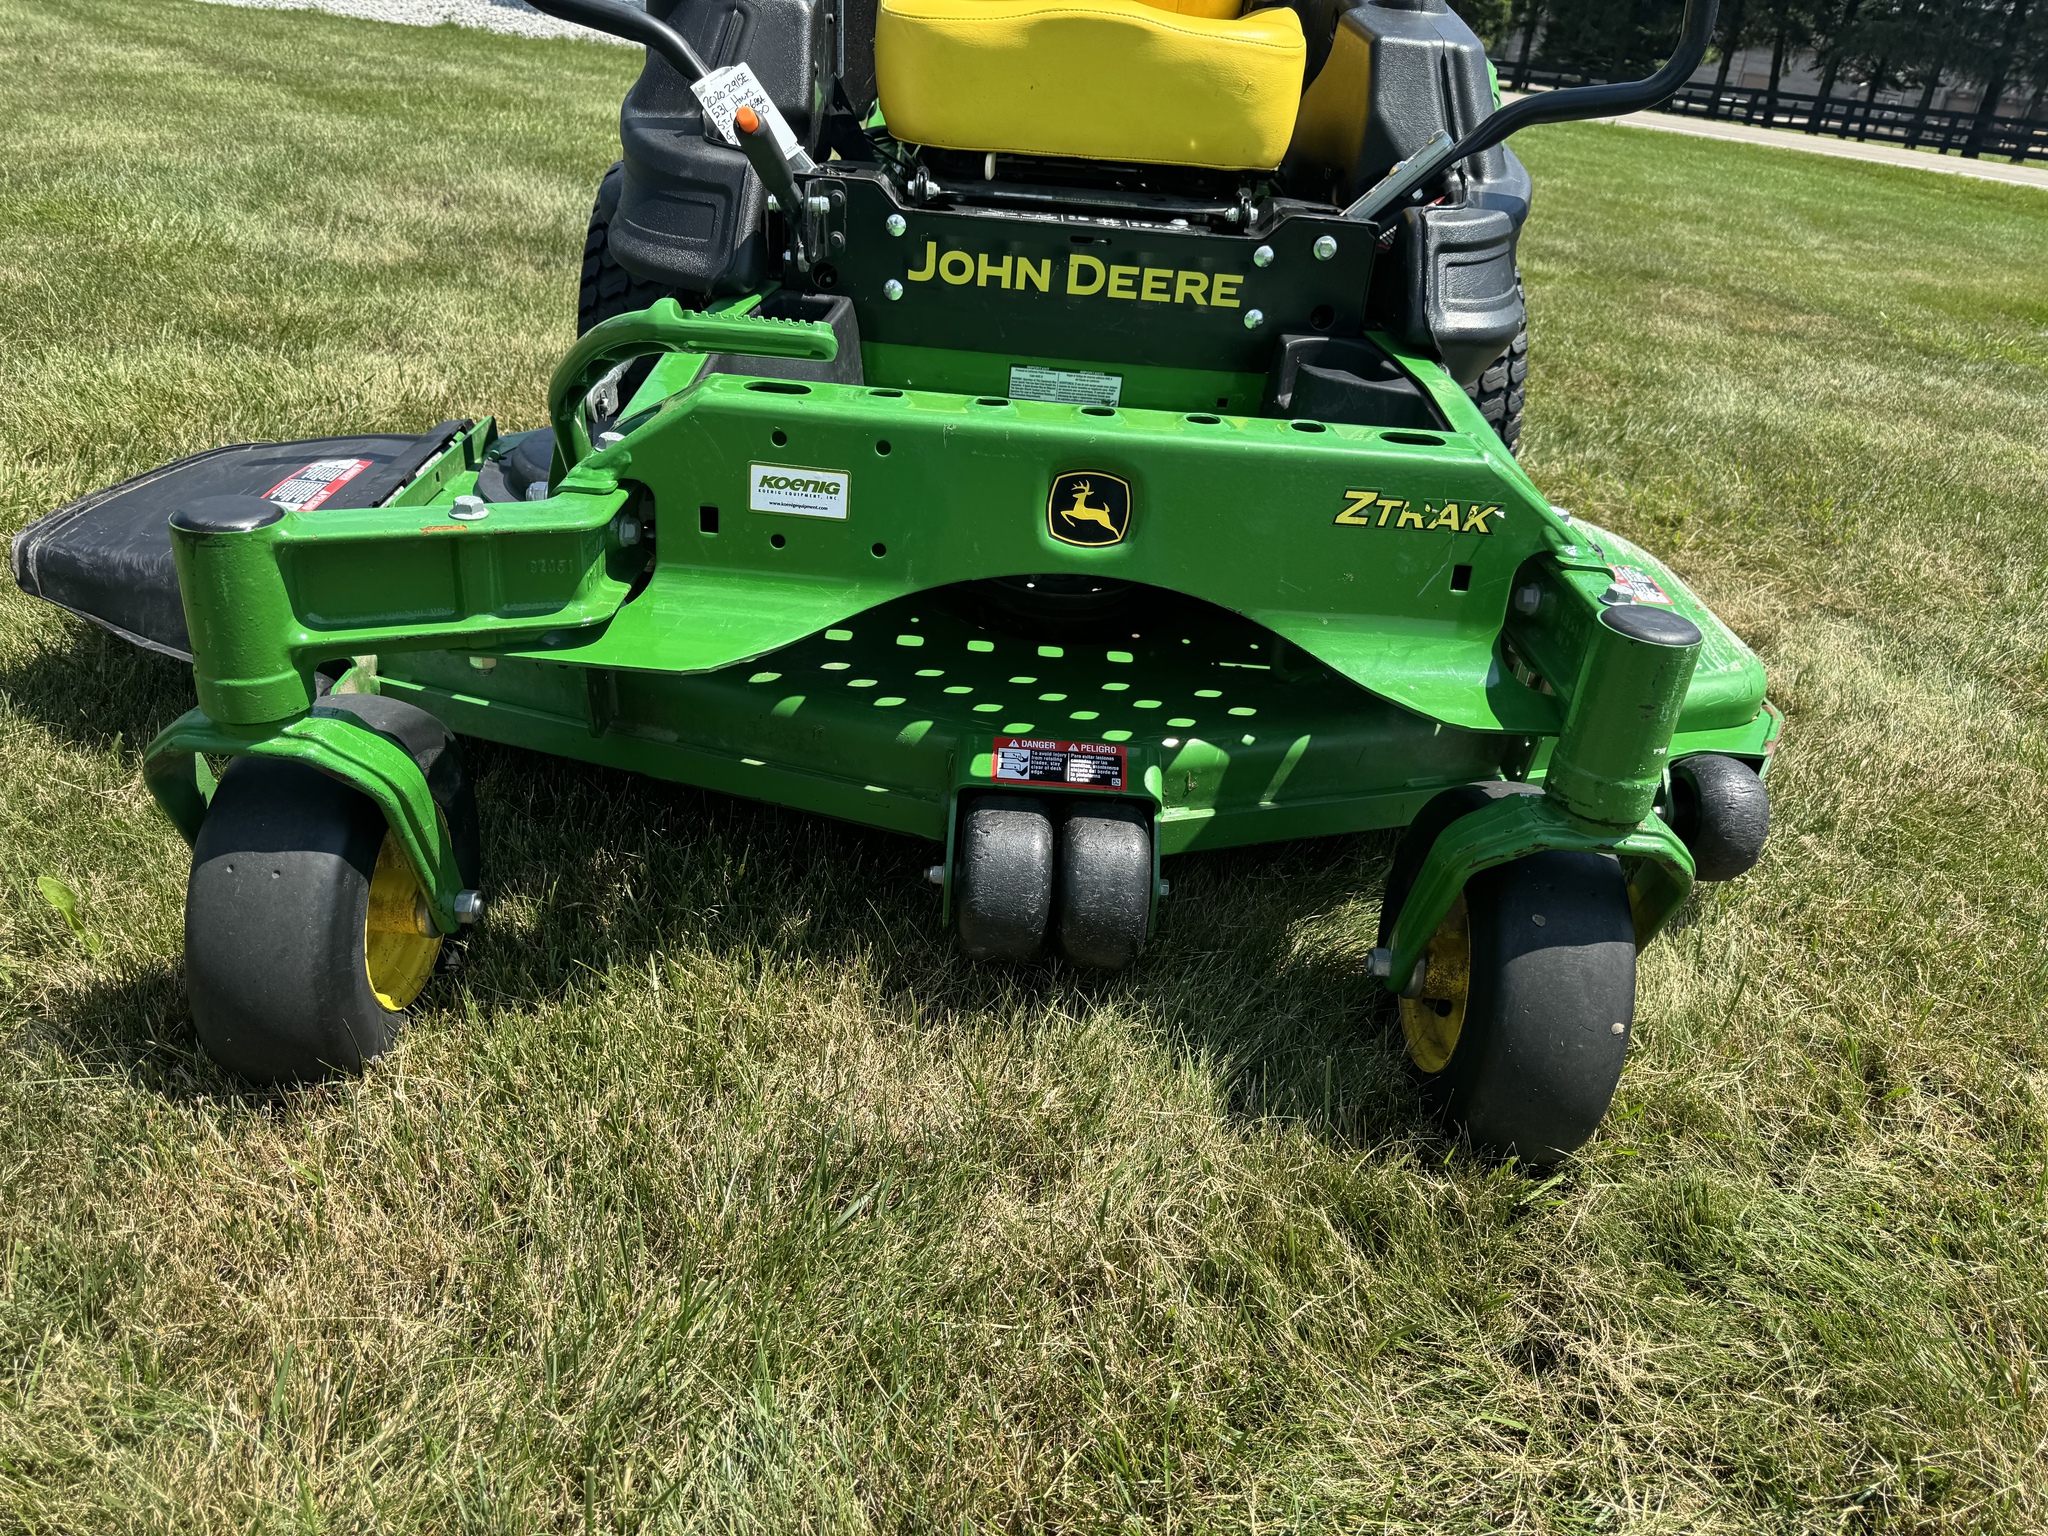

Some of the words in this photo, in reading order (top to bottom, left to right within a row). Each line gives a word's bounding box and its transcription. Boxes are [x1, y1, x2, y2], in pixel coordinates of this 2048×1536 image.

[703, 90, 726, 109] 2020
[907, 241, 1052, 293] JOHN
[1066, 253, 1245, 308] DEERE
[785, 491, 823, 500] EQUIPMENT,
[769, 501, 828, 511] www.koenigequipment.com
[1021, 739, 1056, 750] DANGER
[1081, 744, 1117, 754] PELIGRO
